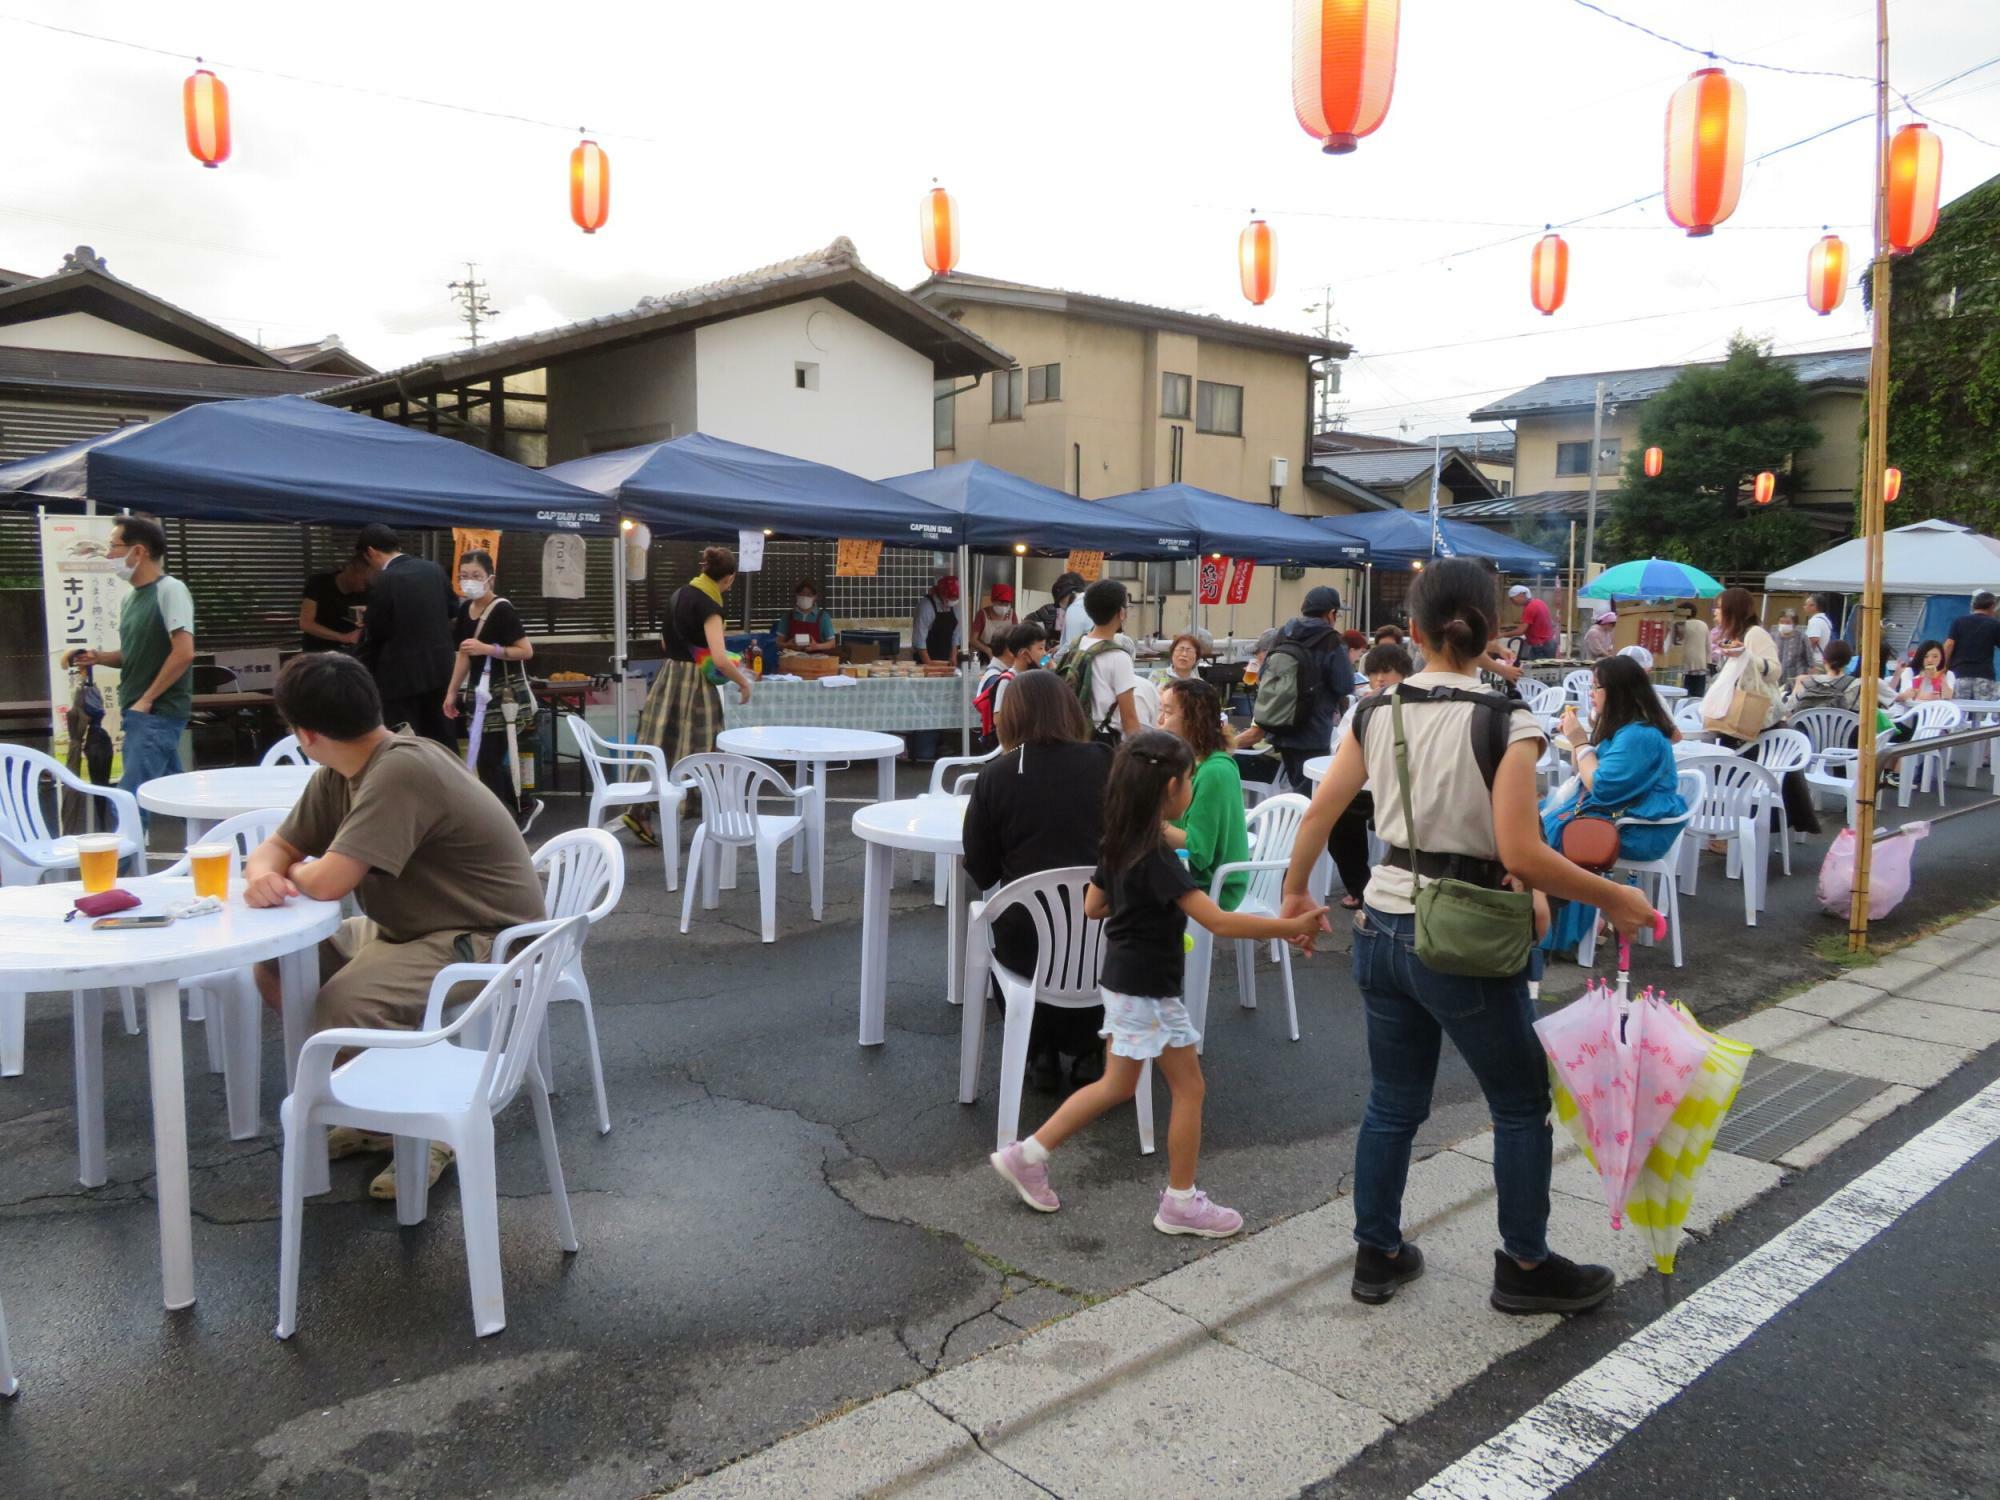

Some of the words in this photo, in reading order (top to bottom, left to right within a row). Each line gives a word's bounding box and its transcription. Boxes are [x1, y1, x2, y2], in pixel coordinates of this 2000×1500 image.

[536, 510, 577, 521] CAPTAIN
[577, 512, 601, 522] STAG
[910, 523, 936, 533] CAPTAIN
[937, 525, 953, 534] STAG
[1202, 562, 1218, 599] やきとり
